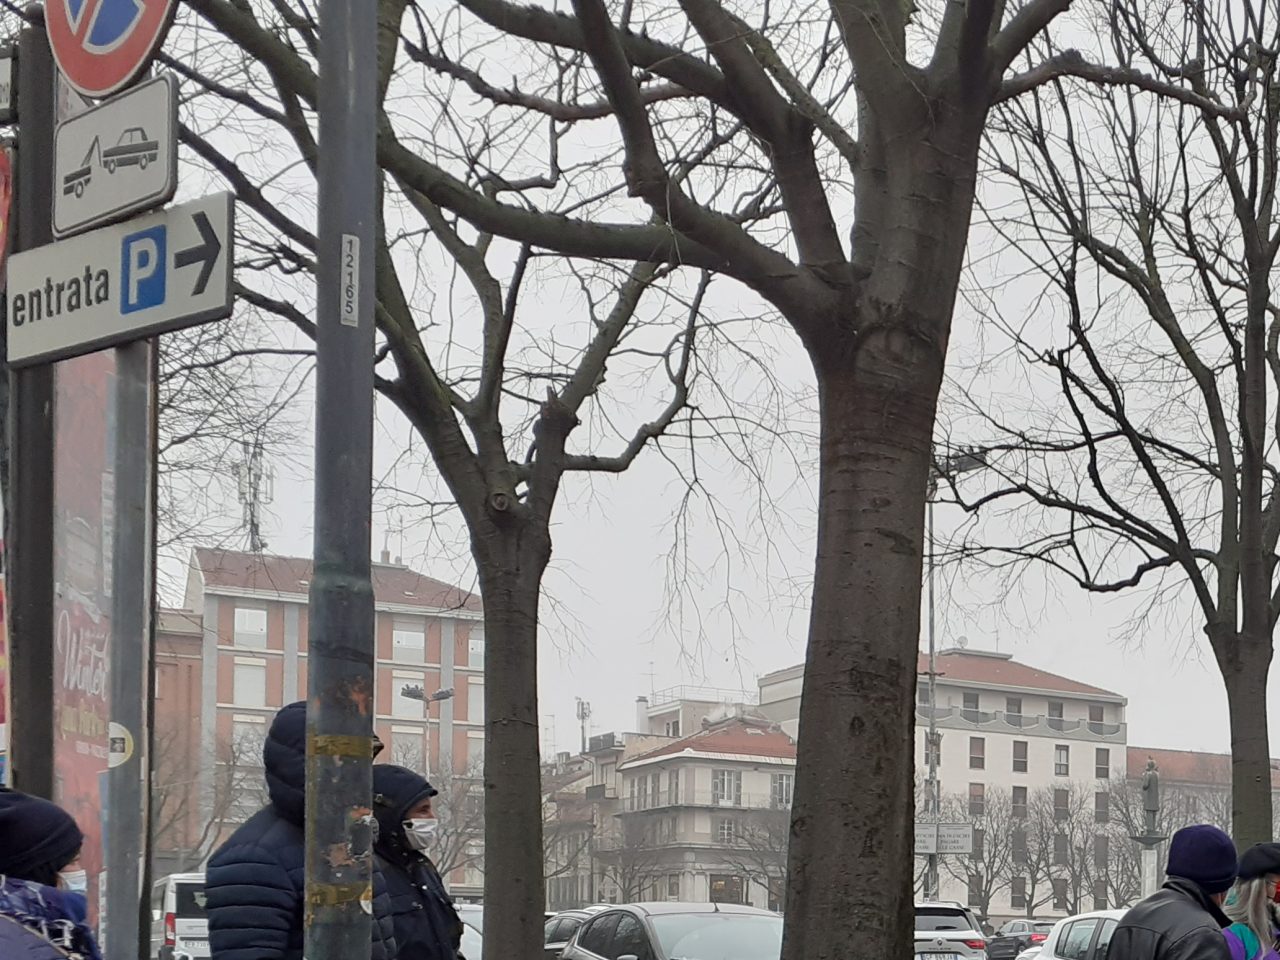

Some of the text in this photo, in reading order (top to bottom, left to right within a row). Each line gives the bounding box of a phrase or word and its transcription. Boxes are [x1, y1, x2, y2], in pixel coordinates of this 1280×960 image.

[12, 237, 159, 328] entrata P
[345, 239, 354, 314] 12165
